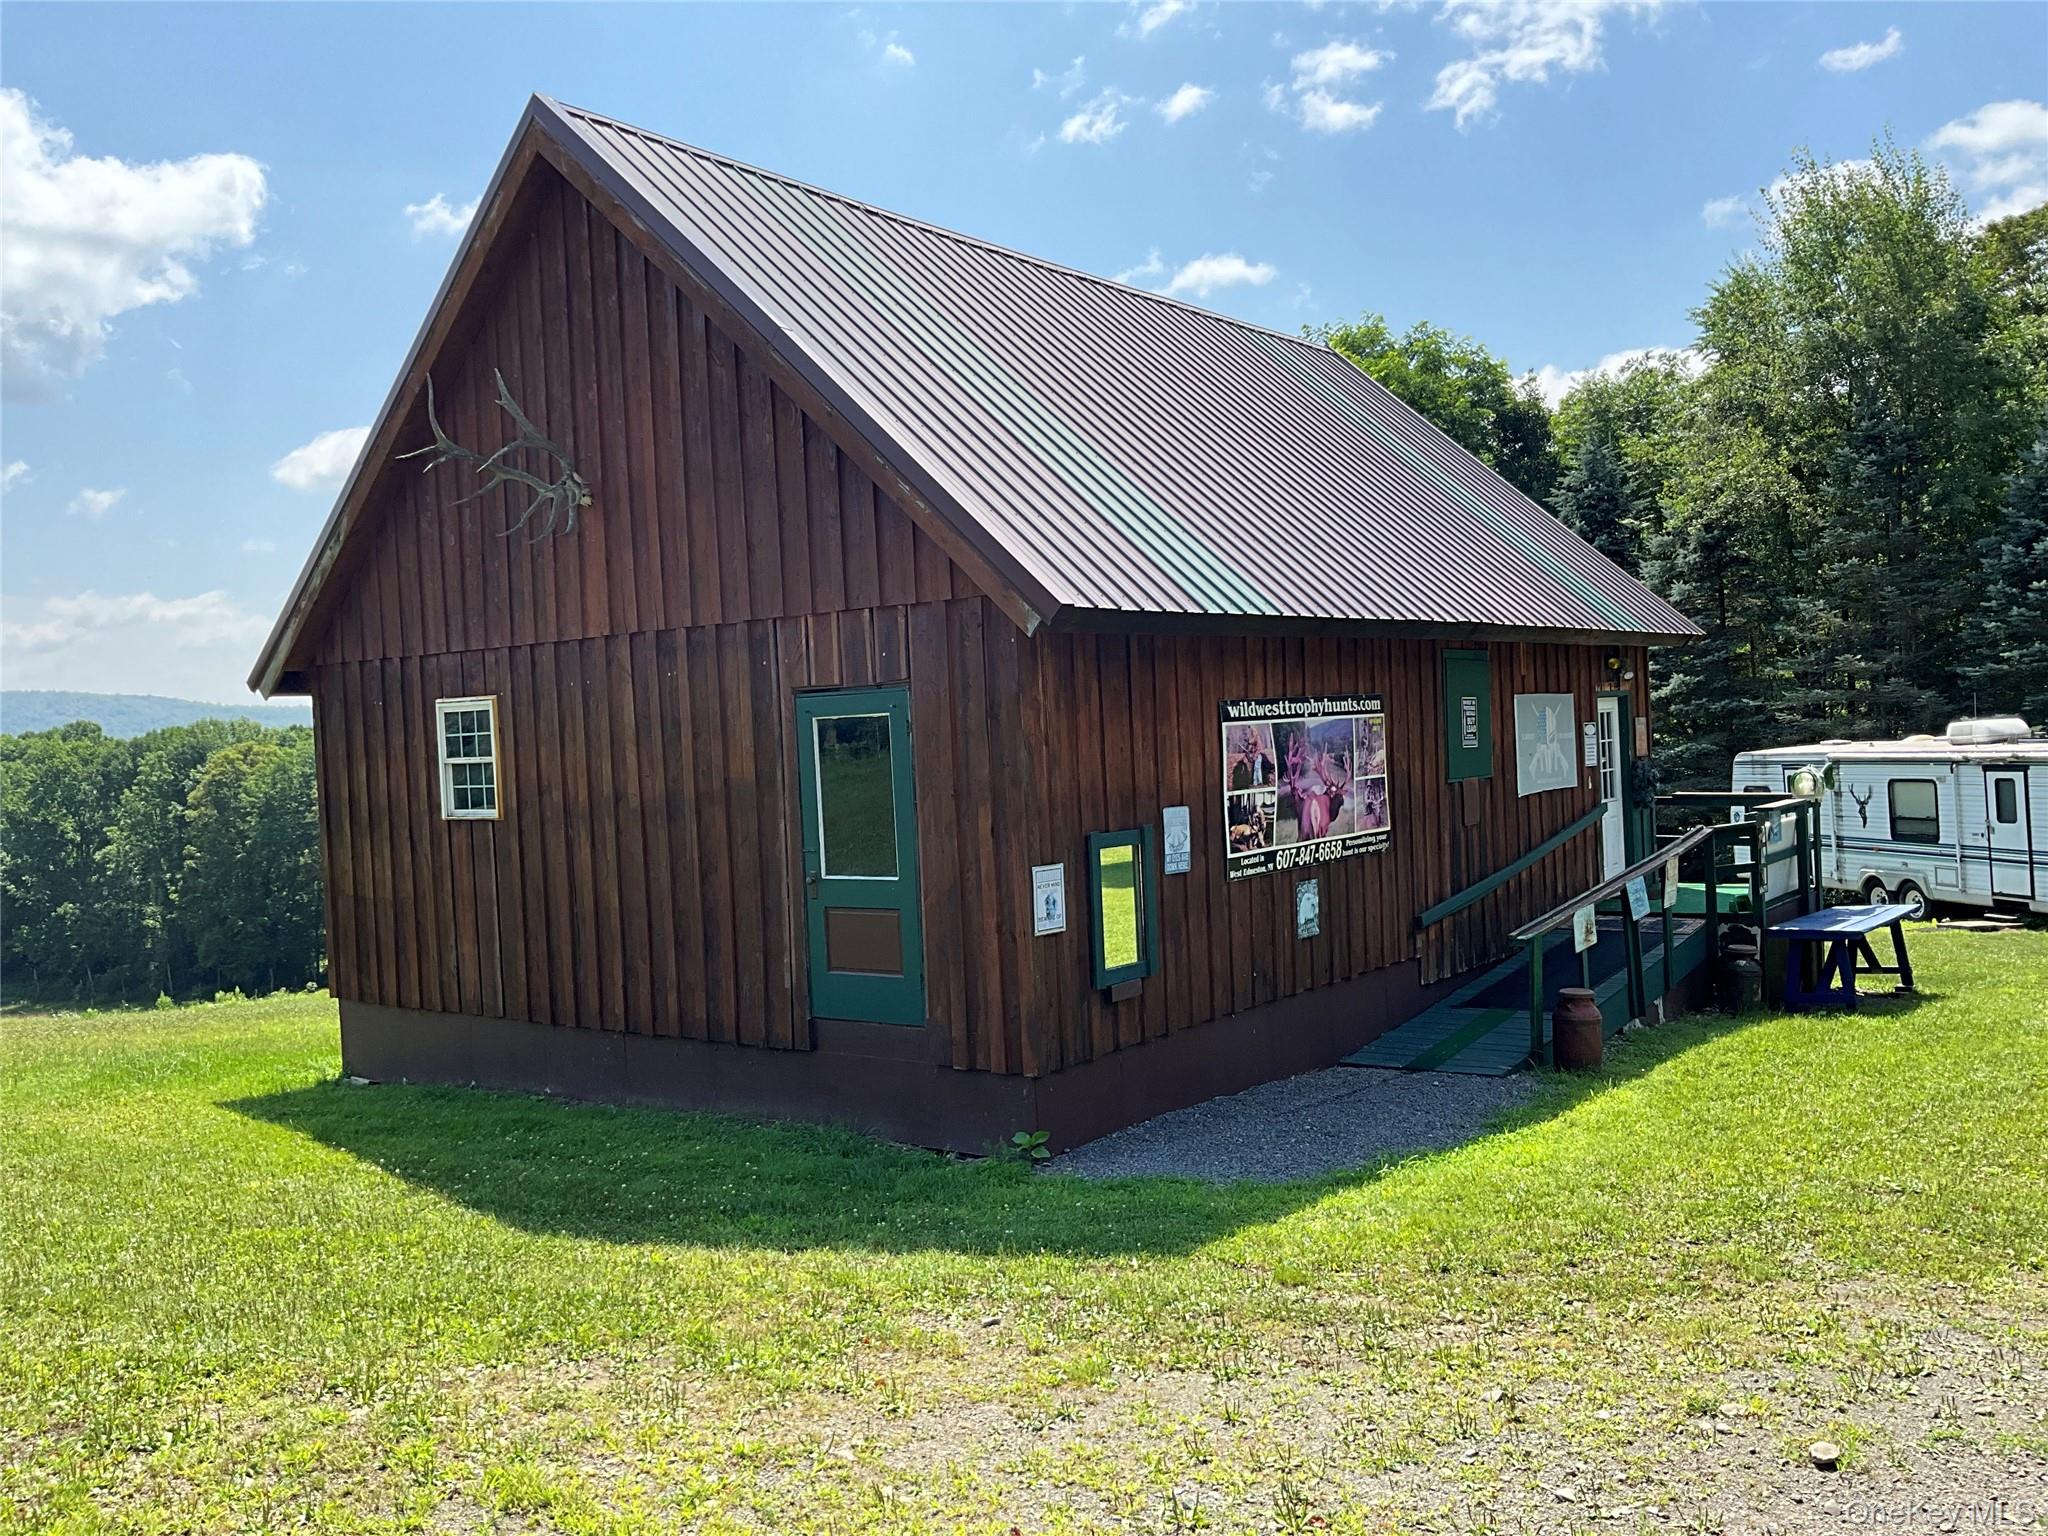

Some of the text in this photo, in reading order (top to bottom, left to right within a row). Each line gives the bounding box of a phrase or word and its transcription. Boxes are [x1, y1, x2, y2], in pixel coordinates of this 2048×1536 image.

[1227, 698, 1381, 717] wildwesttrophyhunts.com
[1240, 855, 1259, 866] Located
[1276, 841, 1342, 869] 607-847-6658
[1229, 868, 1242, 878] West
